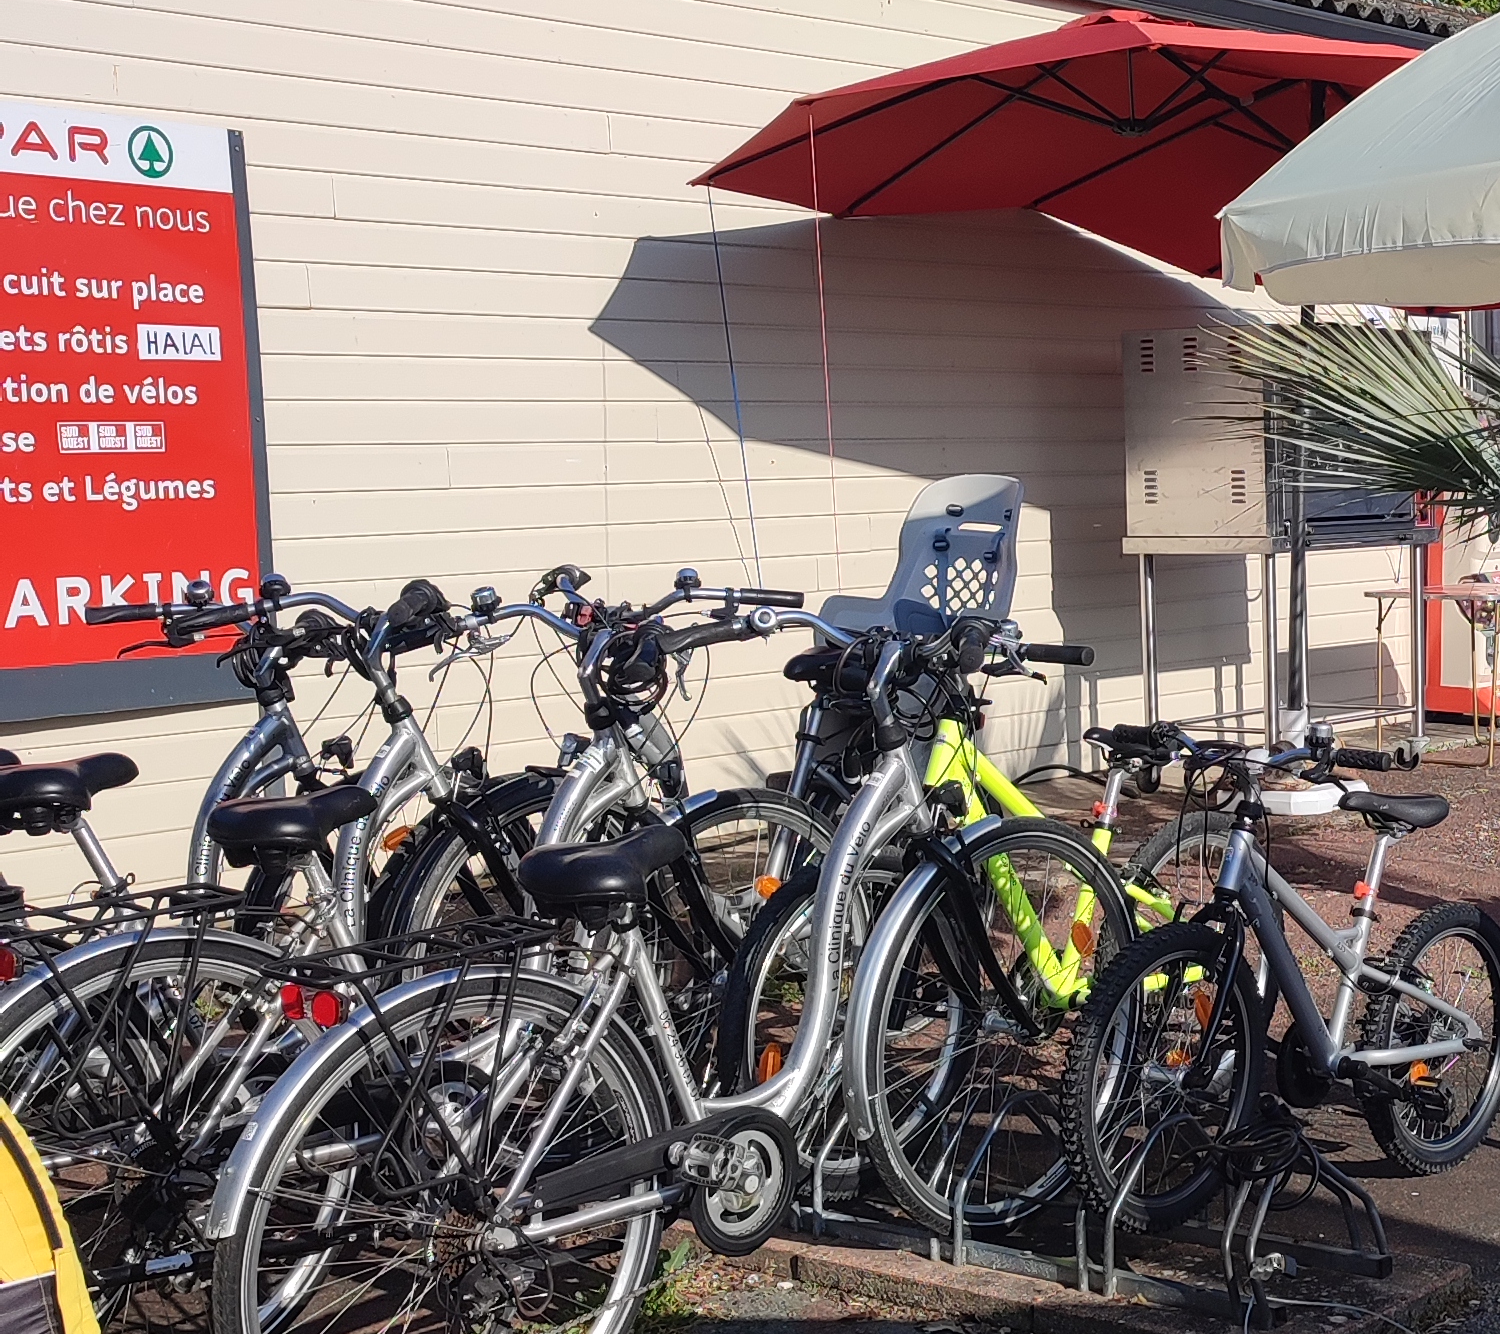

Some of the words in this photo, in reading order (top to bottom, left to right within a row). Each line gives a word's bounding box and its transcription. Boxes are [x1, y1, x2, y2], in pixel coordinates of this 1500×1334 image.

[0, 120, 109, 165] AR
[49, 188, 126, 227] chez
[135, 204, 211, 233] nous
[3, 267, 67, 297] cuit
[75, 276, 123, 299] sur
[131, 273, 205, 310] place
[58, 325, 129, 355] rôtis
[0, 374, 70, 403] tion
[79, 375, 115, 404] de
[123, 376, 198, 405] vélos
[42, 476, 77, 502] et
[85, 472, 216, 511] Légumes
[340, 836, 363, 903] Clinique
[372, 774, 391, 799] élo
[847, 820, 872, 856] Vélo
[840, 864, 855, 886] du
[827, 891, 848, 965] Clinique
